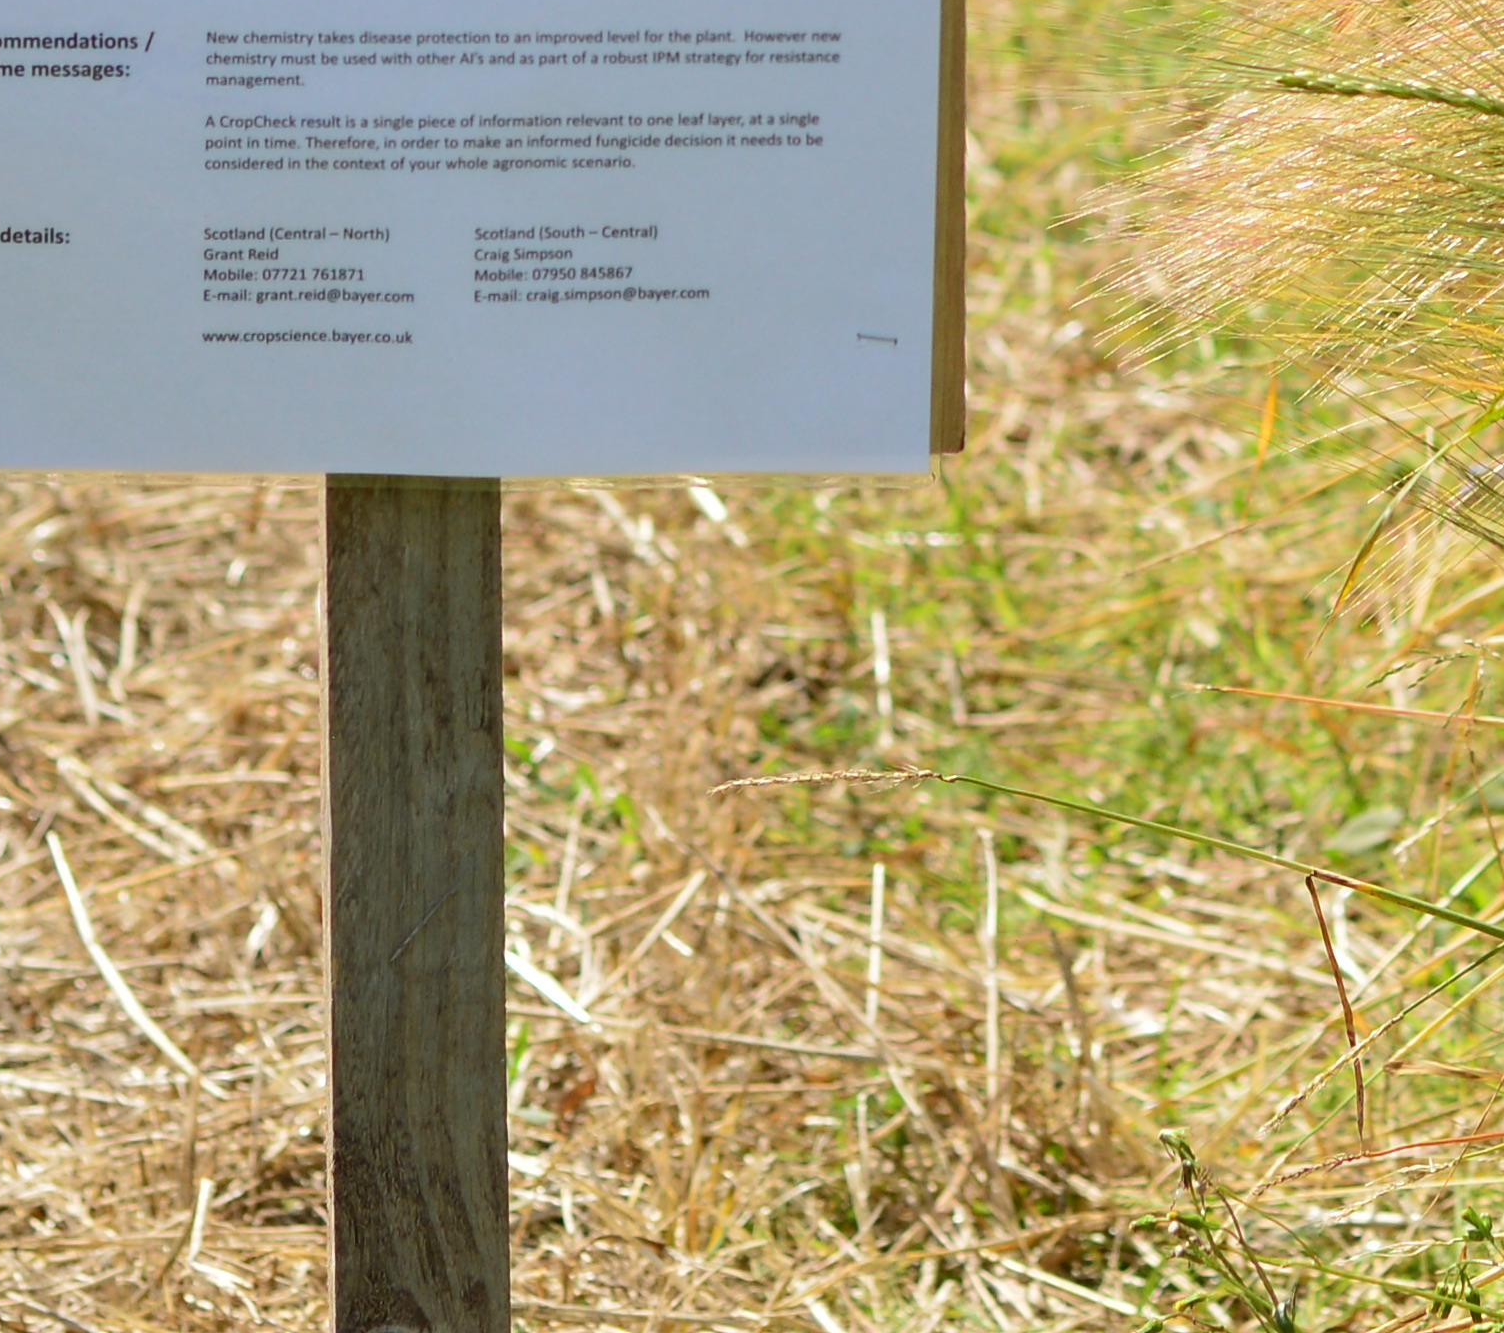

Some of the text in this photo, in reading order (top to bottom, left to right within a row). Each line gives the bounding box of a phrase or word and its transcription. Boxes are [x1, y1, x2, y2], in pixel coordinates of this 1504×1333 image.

[144, 31, 155, 53] /
[31, 64, 130, 82] messages:
[204, 156, 285, 171] considered
[287, 156, 301, 170] in
[304, 156, 329, 171] the
[332, 158, 386, 171] context
[389, 156, 406, 171] of
[408, 159, 442, 173] your
[444, 156, 489, 170] whole
[492, 156, 568, 173] agronomic
[0, 226, 70, 245] details:
[203, 226, 266, 241] Scotland
[269, 226, 327, 243] (Central
[342, 227, 391, 244] North)
[474, 226, 536, 241] Scotland
[538, 225, 586, 242] (South
[601, 224, 659, 241] Central)
[203, 246, 280, 262] Grant Reid
[473, 247, 574, 264] Craig Simpson
[203, 267, 365, 282] Mobile: 07721 761871
[473, 266, 633, 282] Mobile: 07950 845867
[202, 287, 415, 305] E-mail: grant.reid@bayer.com
[473, 286, 711, 305] E-mail: craig.simpson@bayer.com
[201, 328, 413, 346] www.cropscience.bayer.co.uk
